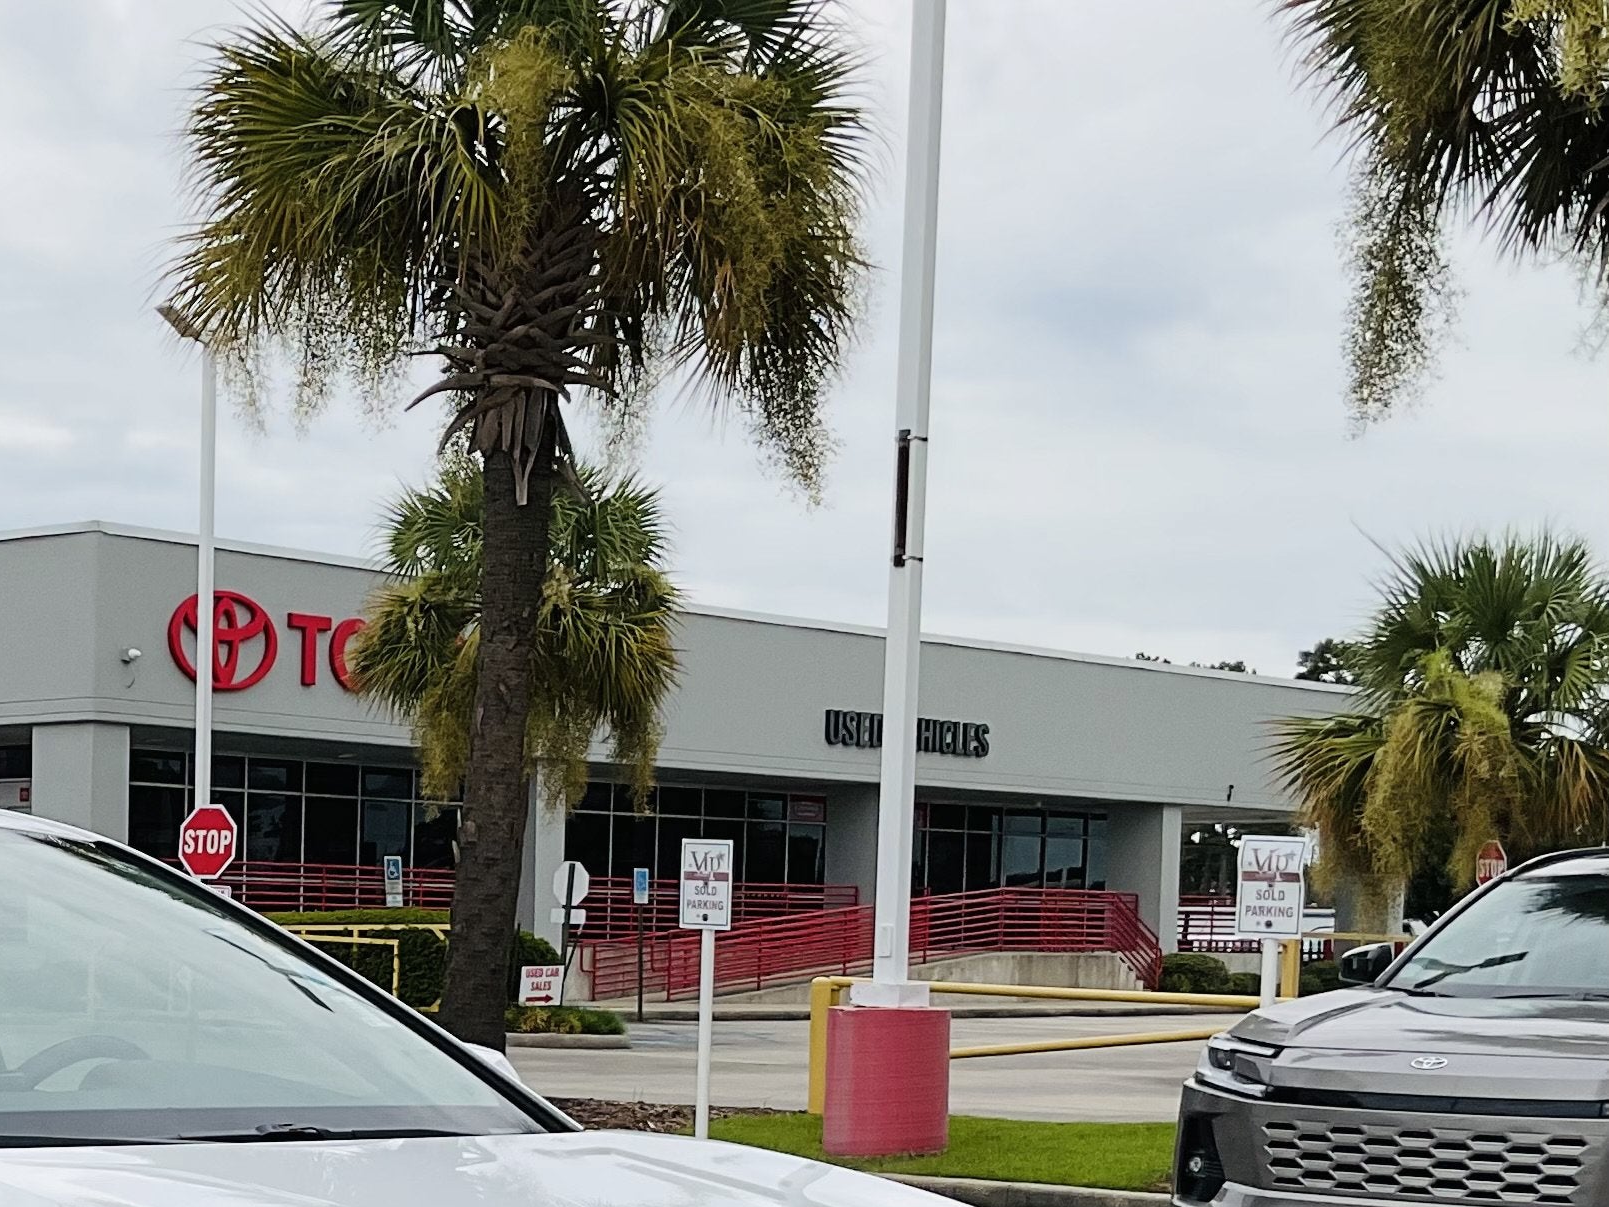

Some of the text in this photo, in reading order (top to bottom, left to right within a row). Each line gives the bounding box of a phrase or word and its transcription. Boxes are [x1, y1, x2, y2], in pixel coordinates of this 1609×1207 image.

[917, 717, 990, 757] HICLES
[183, 828, 232, 855] STOP
[1479, 858, 1504, 878] STOP
[694, 885, 717, 896] SOLD
[1255, 889, 1285, 901] SOLD
[686, 899, 724, 911] PARKING
[1244, 905, 1294, 918] PARKING
[525, 967, 559, 978] USED CAR
[530, 980, 552, 991] SALES
